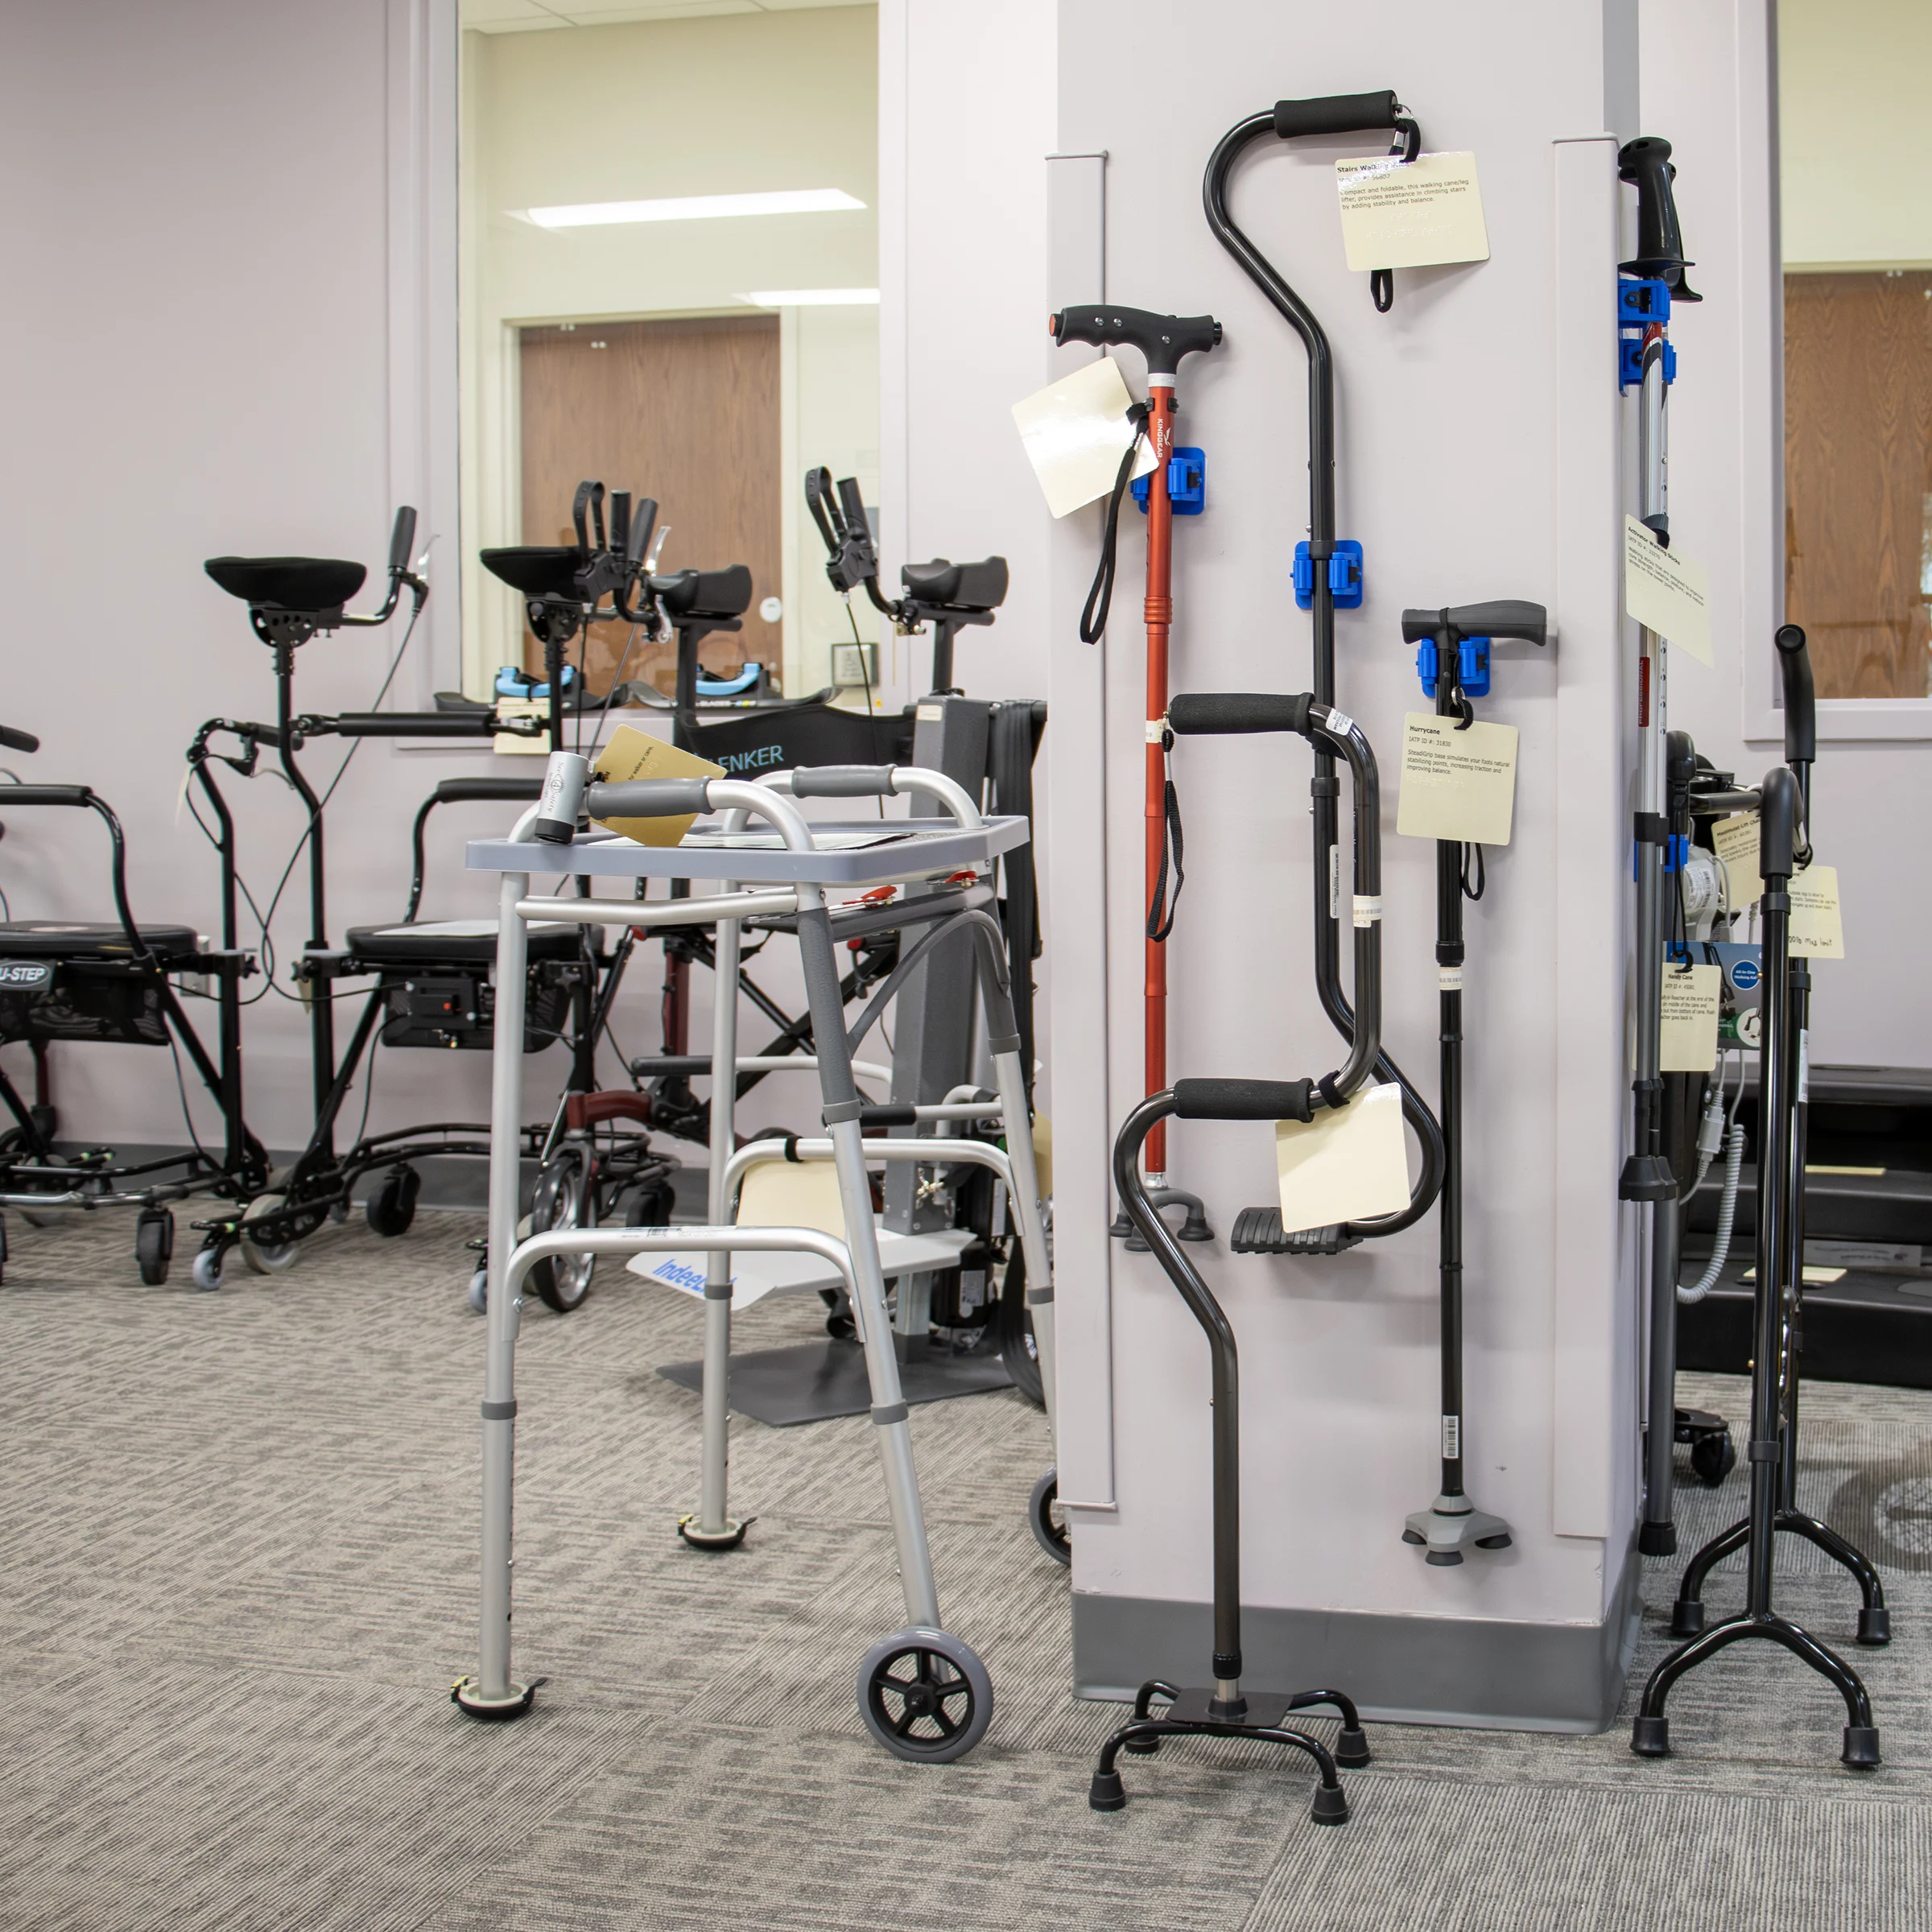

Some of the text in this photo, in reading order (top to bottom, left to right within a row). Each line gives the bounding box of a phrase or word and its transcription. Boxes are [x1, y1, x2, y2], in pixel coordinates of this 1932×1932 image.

[1443, 179, 1469, 188] cane/leg
[1358, 194, 1383, 202] provides
[1385, 192, 1415, 200] assistance
[1423, 188, 1448, 196] climbing
[1373, 199, 1396, 208] stability
[1410, 196, 1435, 204] balance.
[1410, 725, 1440, 734] Hurrycane
[634, 761, 643, 778] walker
[1406, 764, 1431, 773] improving
[1407, 757, 1431, 766] stabilizing
[1450, 762, 1473, 771] increasing
[0, 967, 46, 980] U-STEP
[653, 1259, 708, 1294] IndeeL
